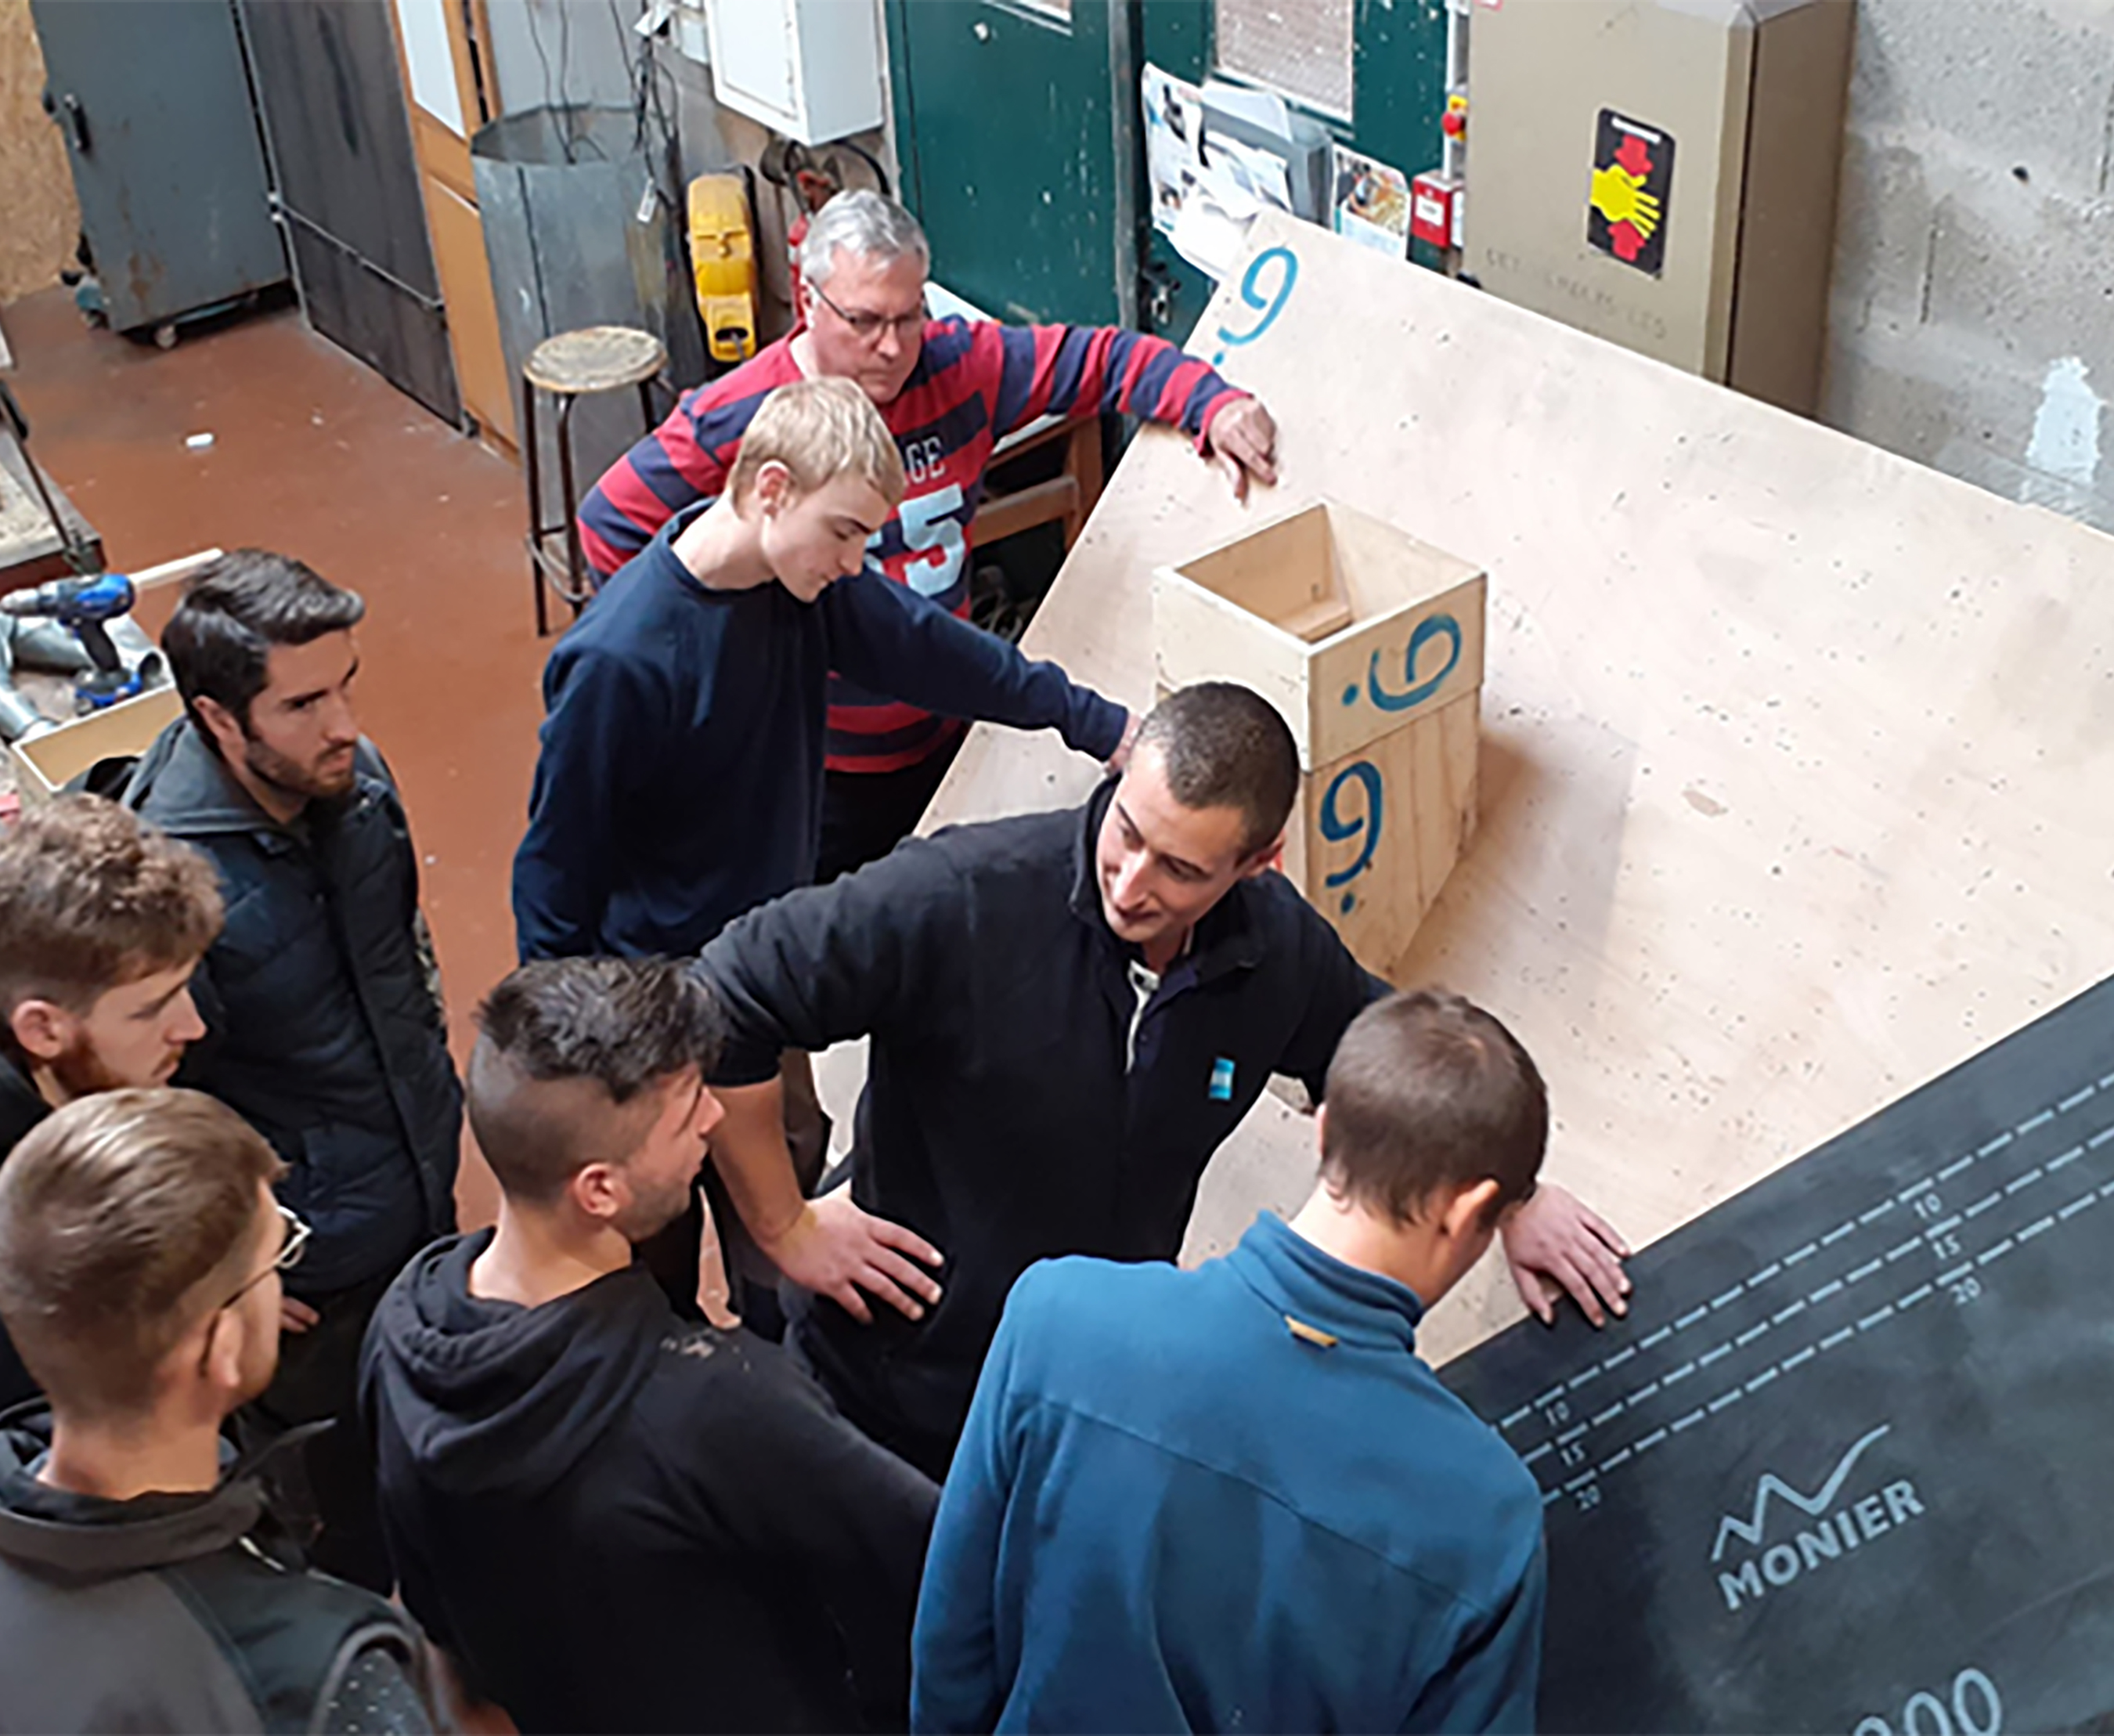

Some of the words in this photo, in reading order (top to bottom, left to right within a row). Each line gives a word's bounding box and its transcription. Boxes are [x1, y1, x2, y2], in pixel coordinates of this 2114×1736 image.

[1914, 1193, 1942, 1218] 10
[1932, 1234, 1961, 1260] 15
[1949, 1277, 1982, 1305] 20
[1546, 1401, 1570, 1427] 10
[1560, 1442, 1586, 1467] 15
[1575, 1485, 1600, 1510] 20
[1719, 1479, 1925, 1610] MONIER
